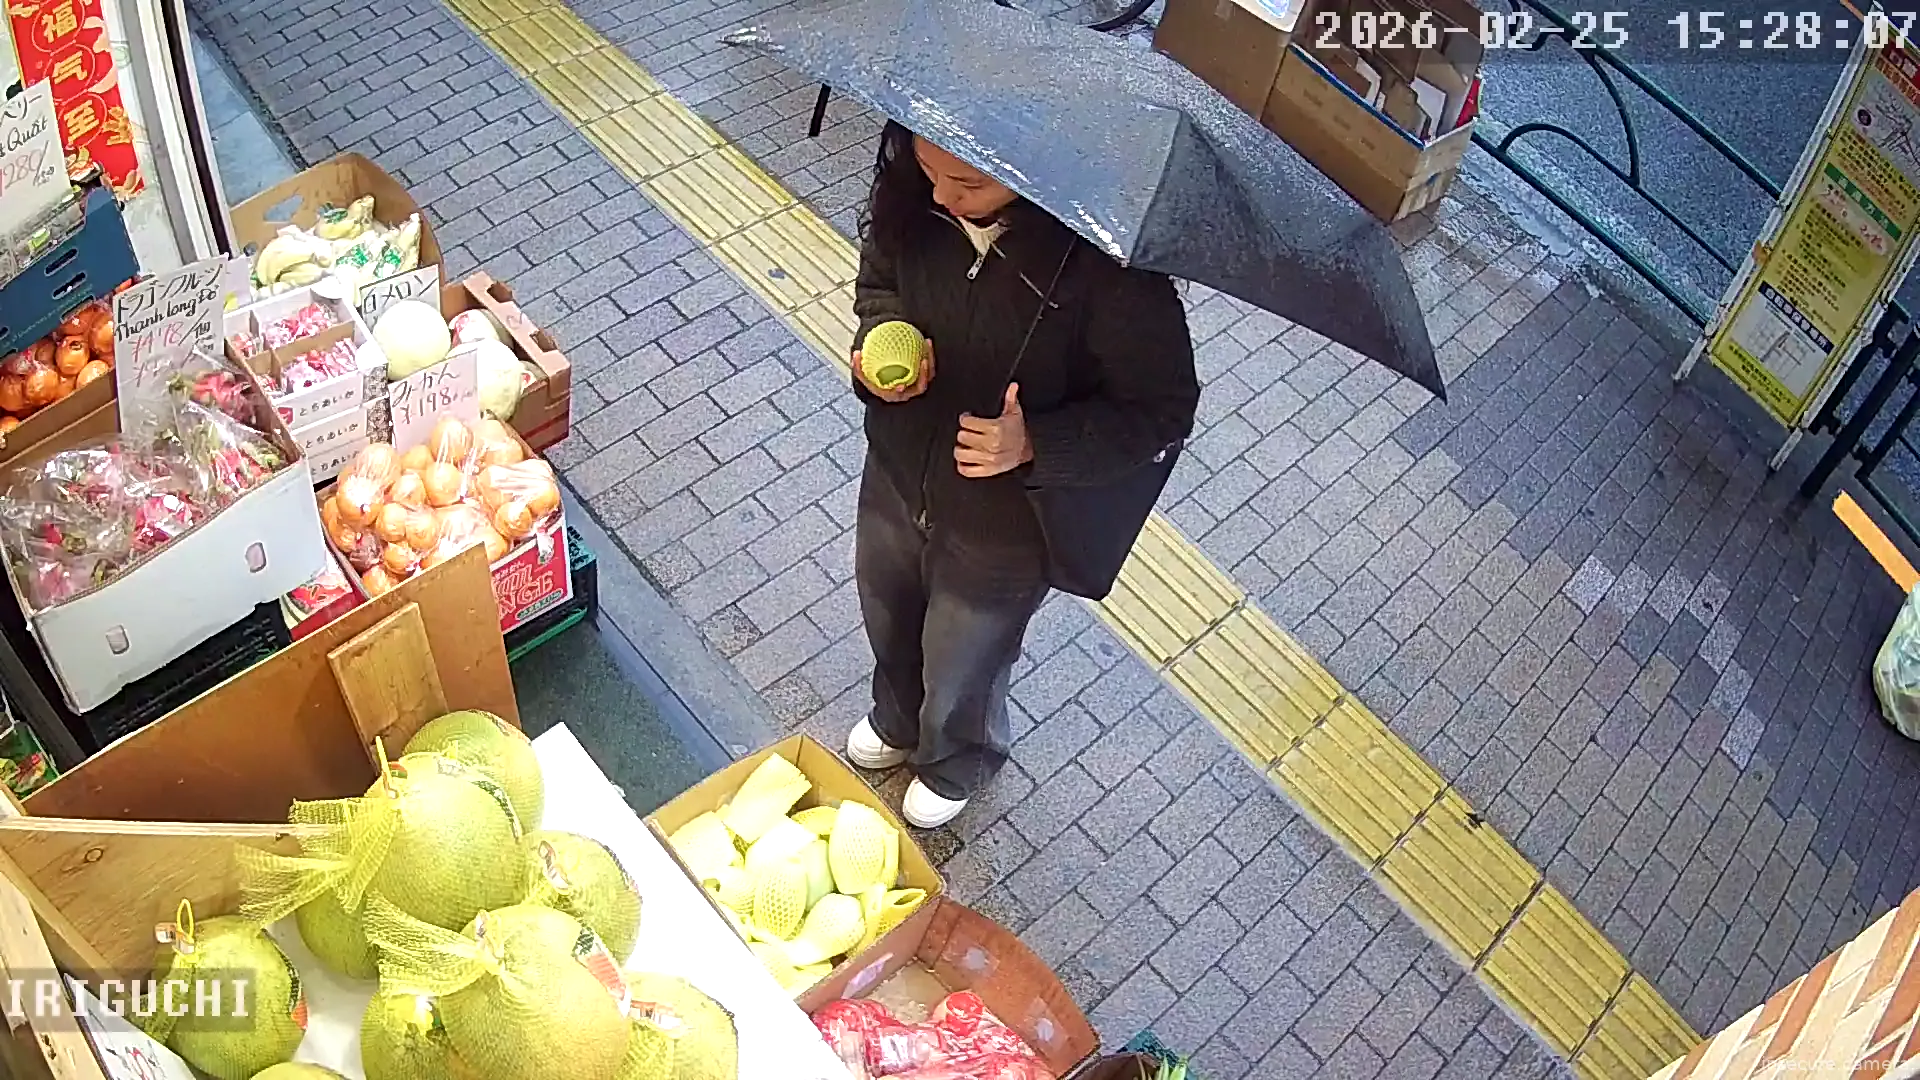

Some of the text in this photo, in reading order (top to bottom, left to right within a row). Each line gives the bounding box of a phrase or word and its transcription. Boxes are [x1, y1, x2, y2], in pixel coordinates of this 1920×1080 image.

[114, 307, 165, 342] Thanh
[167, 300, 197, 317] long
[392, 363, 460, 407] みかん
[299, 390, 354, 417] とちあいか
[305, 423, 358, 449] とちあいか
